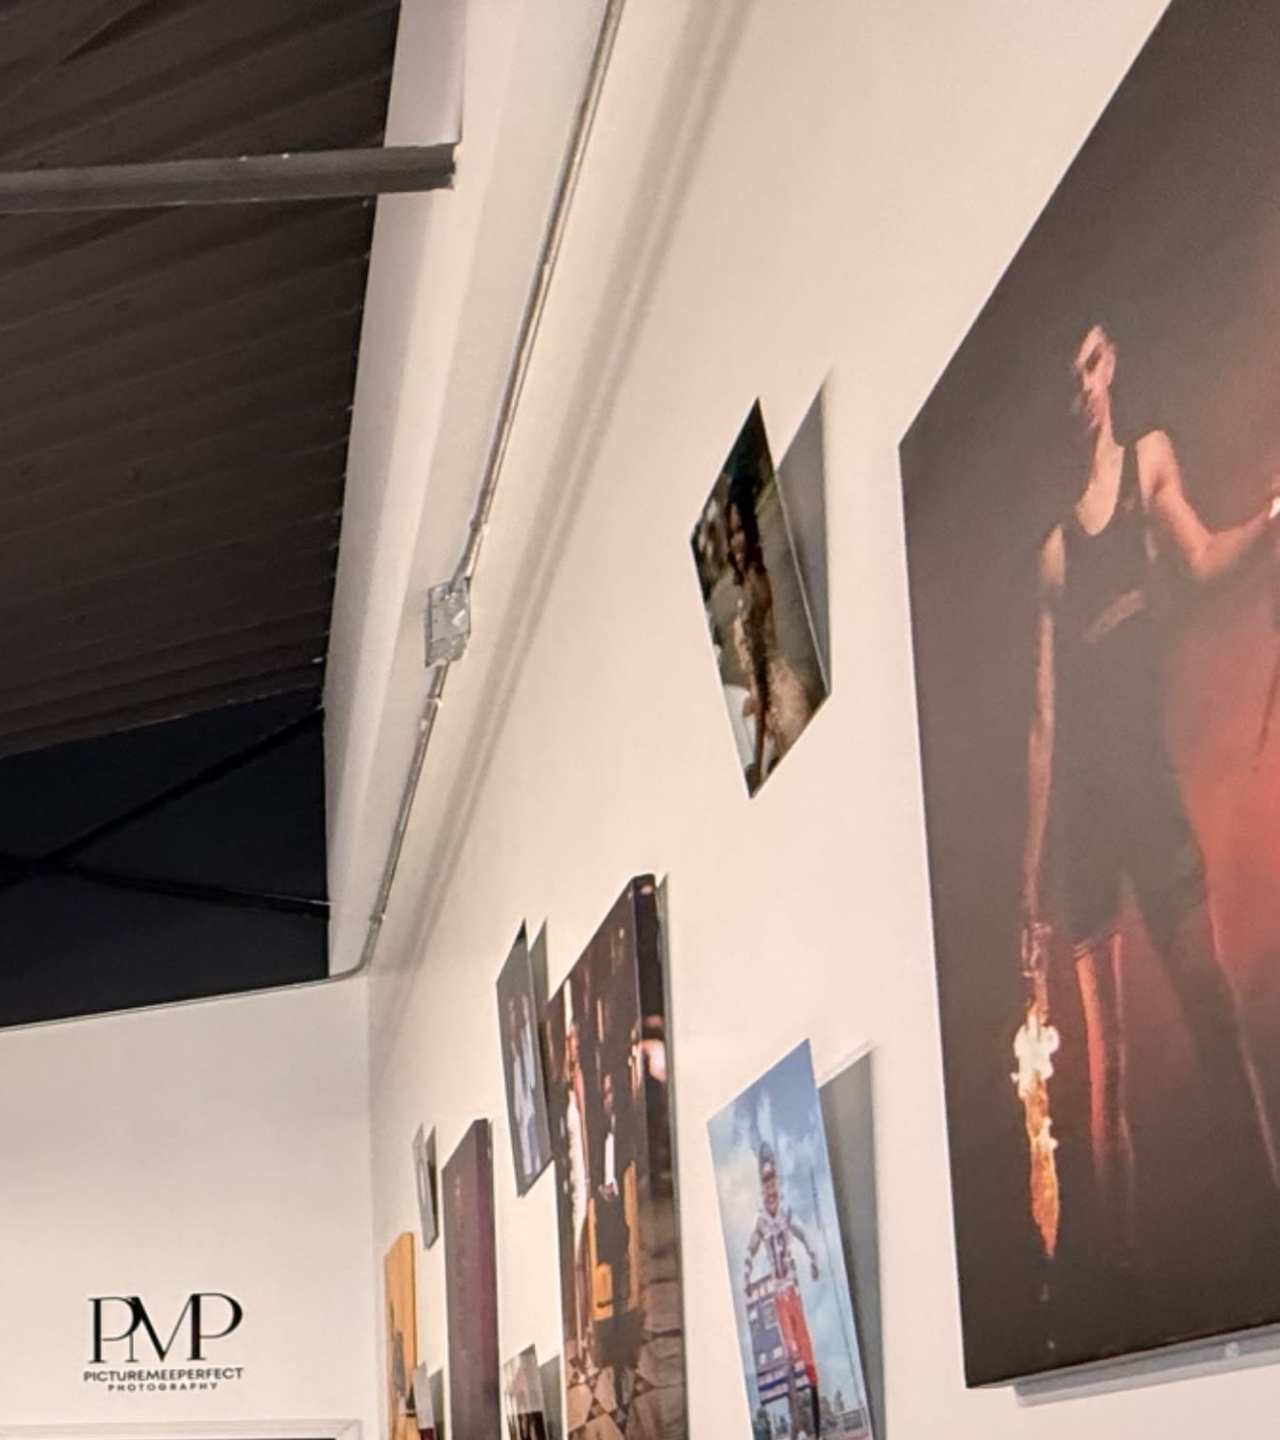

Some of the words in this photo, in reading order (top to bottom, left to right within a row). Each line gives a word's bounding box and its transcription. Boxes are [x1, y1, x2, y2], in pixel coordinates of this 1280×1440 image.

[88, 1292, 243, 1364] PMP
[83, 1367, 244, 1382] PICTUREMEEPERFECT
[107, 1382, 218, 1392] PHOTOGRAPHY
